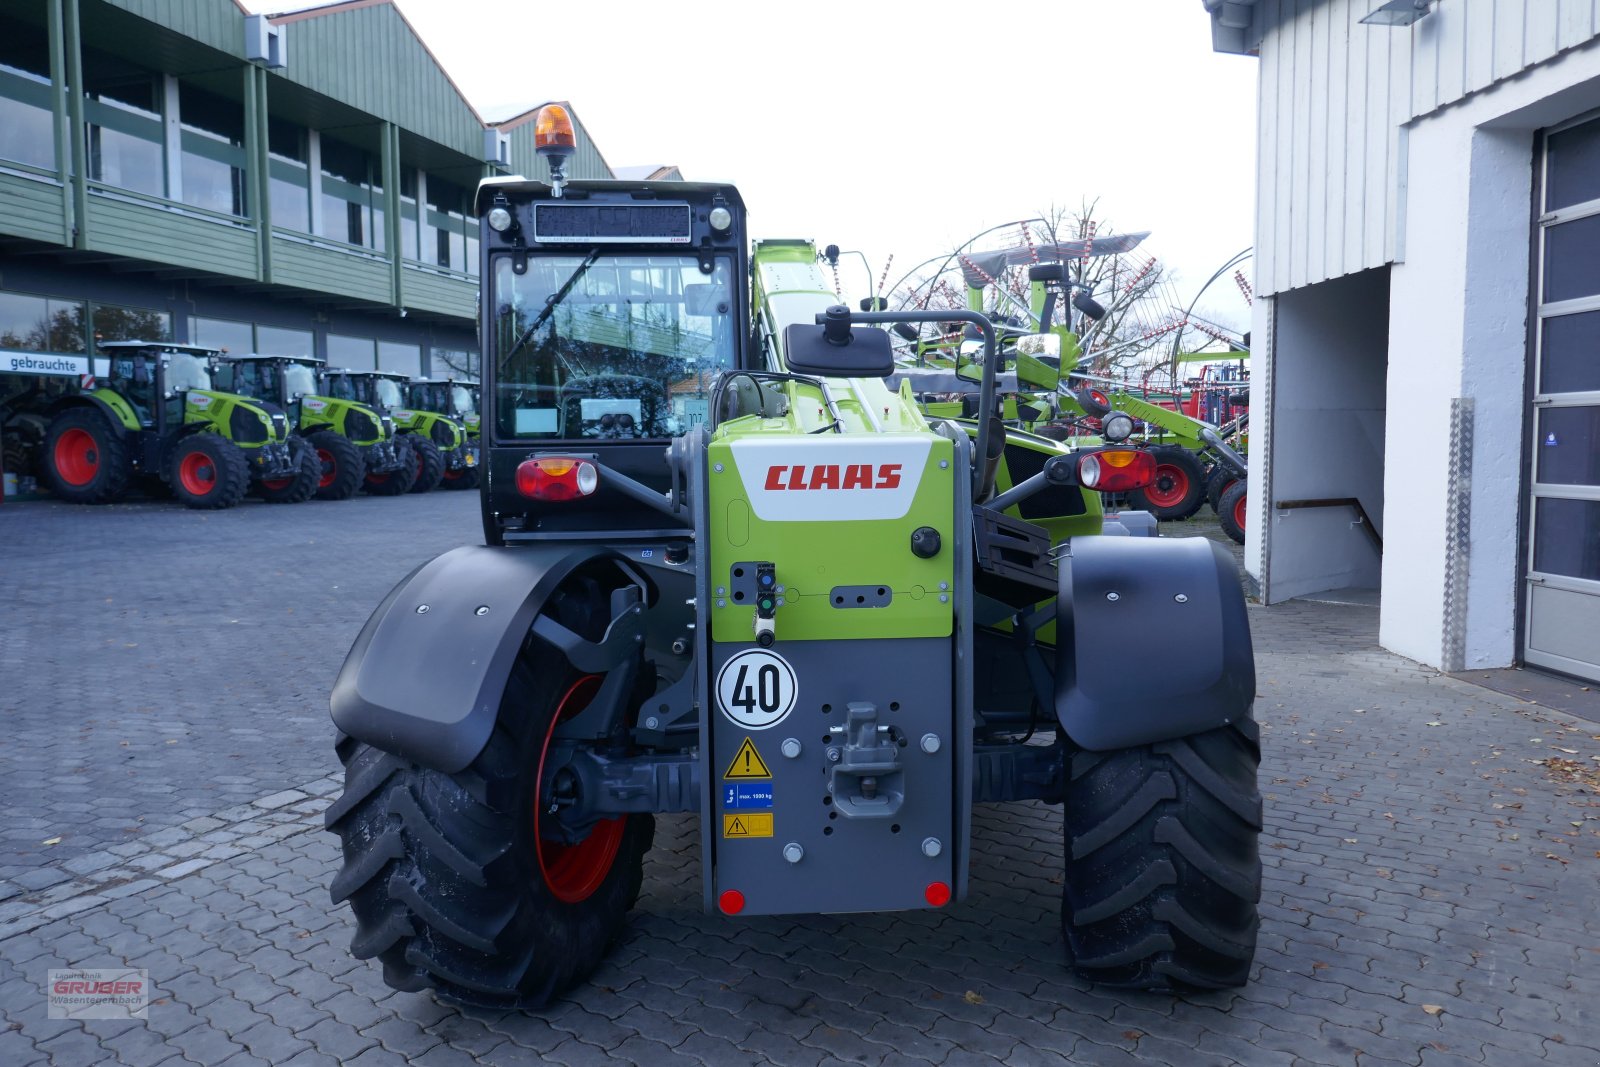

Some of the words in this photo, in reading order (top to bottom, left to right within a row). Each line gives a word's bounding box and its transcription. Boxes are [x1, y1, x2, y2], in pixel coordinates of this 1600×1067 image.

[10, 356, 77, 372] gebrauchte
[764, 464, 902, 490] CLAAS
[731, 664, 781, 713] 40
